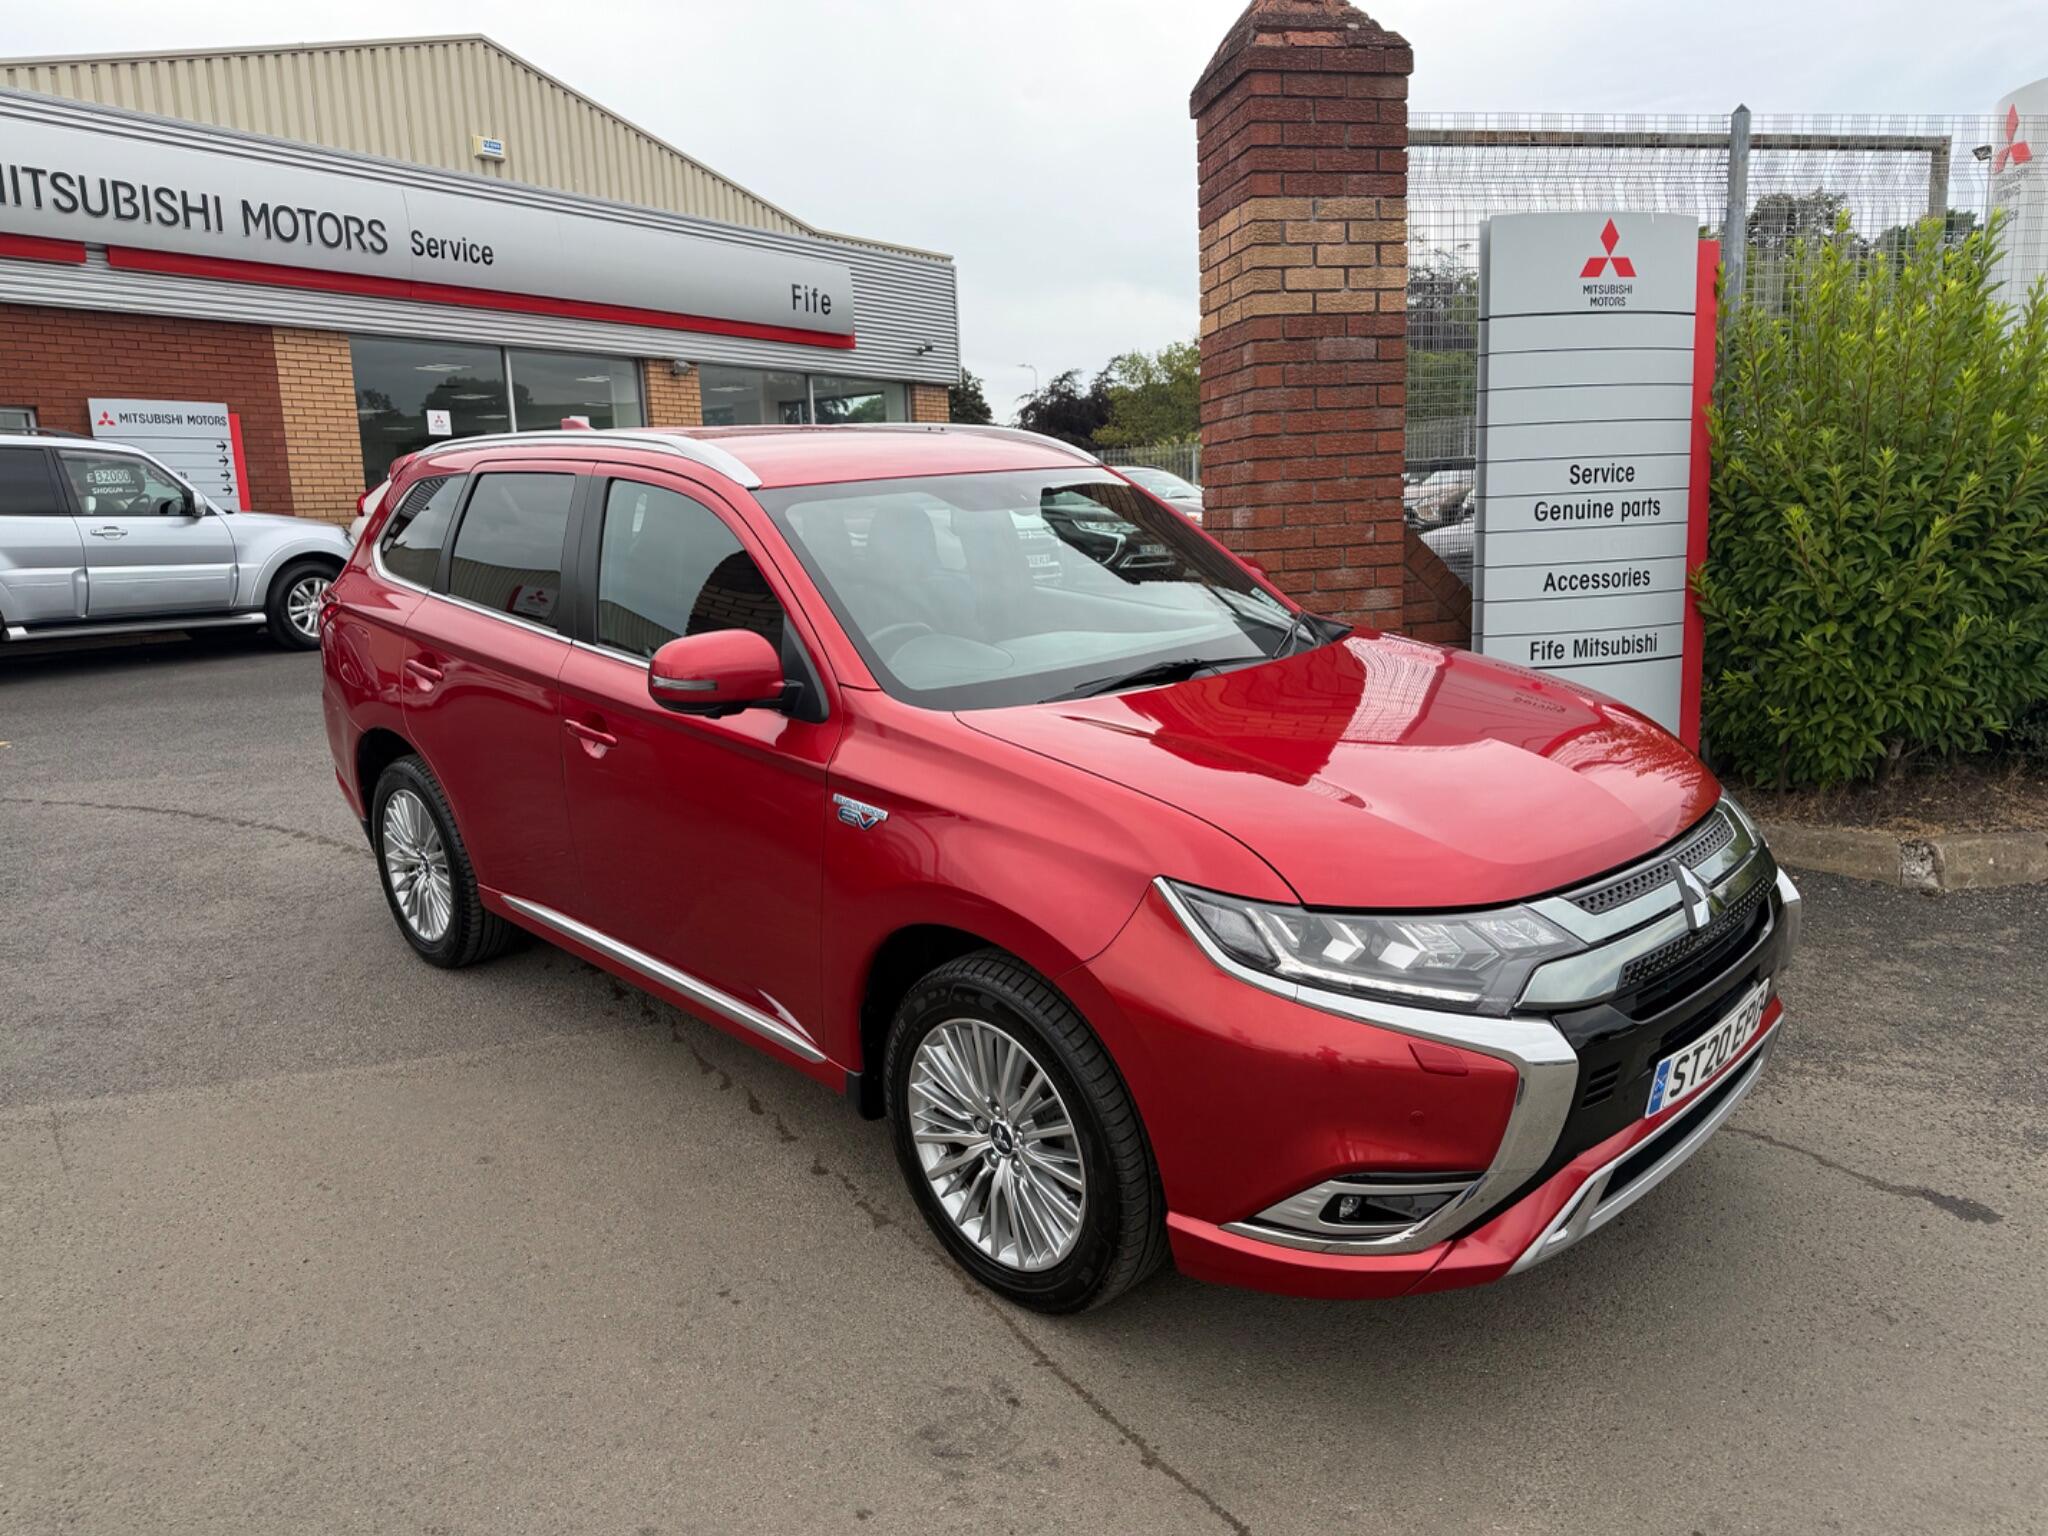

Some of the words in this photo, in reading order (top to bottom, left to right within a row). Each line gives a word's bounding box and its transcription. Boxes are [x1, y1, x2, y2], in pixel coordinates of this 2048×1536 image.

[0, 163, 224, 232] ITSUBISHI
[241, 200, 388, 254] MOTORS
[411, 230, 494, 266] Service
[791, 283, 832, 315] Fife
[1582, 284, 1633, 295] MITSUBISHI
[1590, 296, 1626, 307] MOTORS
[118, 412, 183, 425] MITSUBISHI
[187, 415, 227, 426] MOTORS
[1569, 463, 1635, 485] Service
[1534, 499, 1614, 522] Genuine
[1621, 497, 1661, 522] parts
[1543, 567, 1650, 592] Accessories
[1529, 640, 1565, 661] Fife
[1573, 633, 1658, 658] Mitsubishi
[1669, 1022, 1733, 1098] ST20
